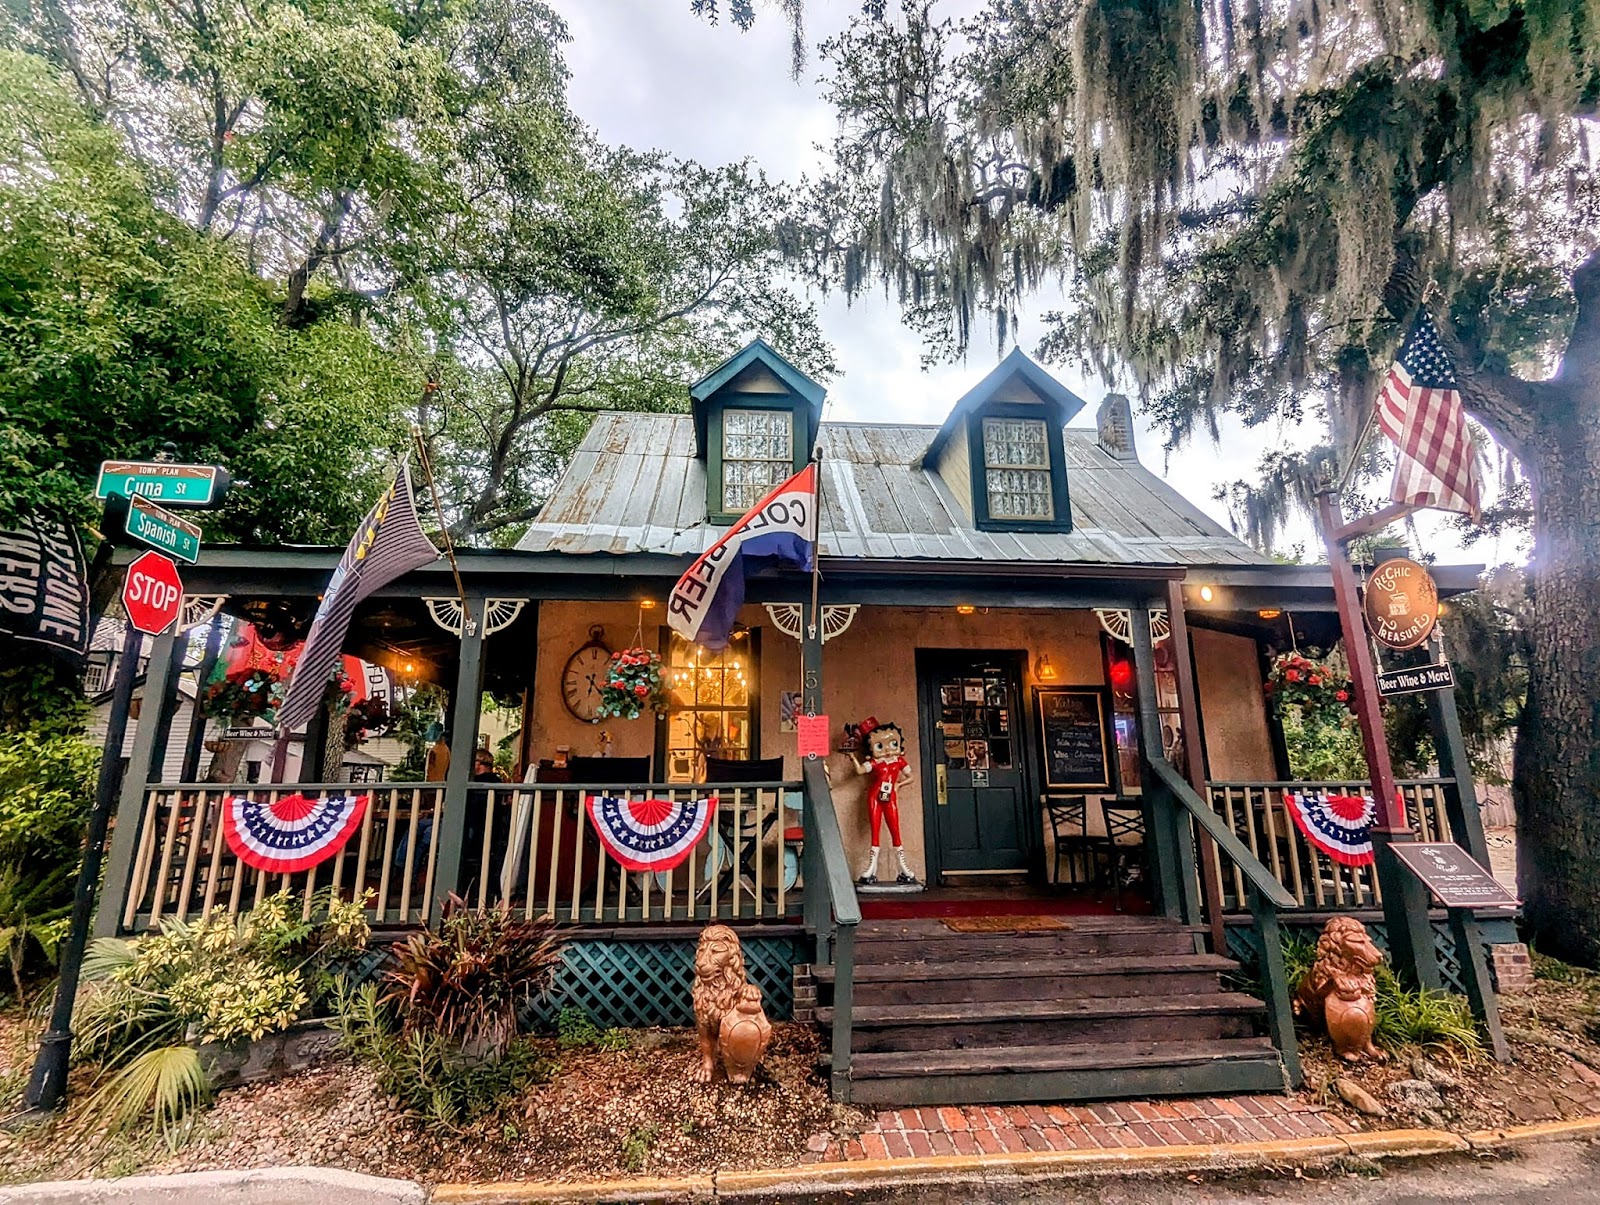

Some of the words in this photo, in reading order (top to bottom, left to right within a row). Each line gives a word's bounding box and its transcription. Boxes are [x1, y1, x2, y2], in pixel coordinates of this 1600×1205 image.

[138, 466, 157, 475] TOWN
[161, 467, 179, 476] PLAN
[124, 477, 163, 497] Cuna
[175, 482, 187, 495] St
[137, 512, 177, 548] Spanish
[182, 537, 191, 551] St
[129, 571, 178, 612] STOP
[1377, 613, 1430, 642] TREASURE
[1379, 678, 1397, 690] Beer
[1397, 674, 1419, 688] Wine
[1419, 672, 1427, 684] &
[1426, 670, 1450, 684] More
